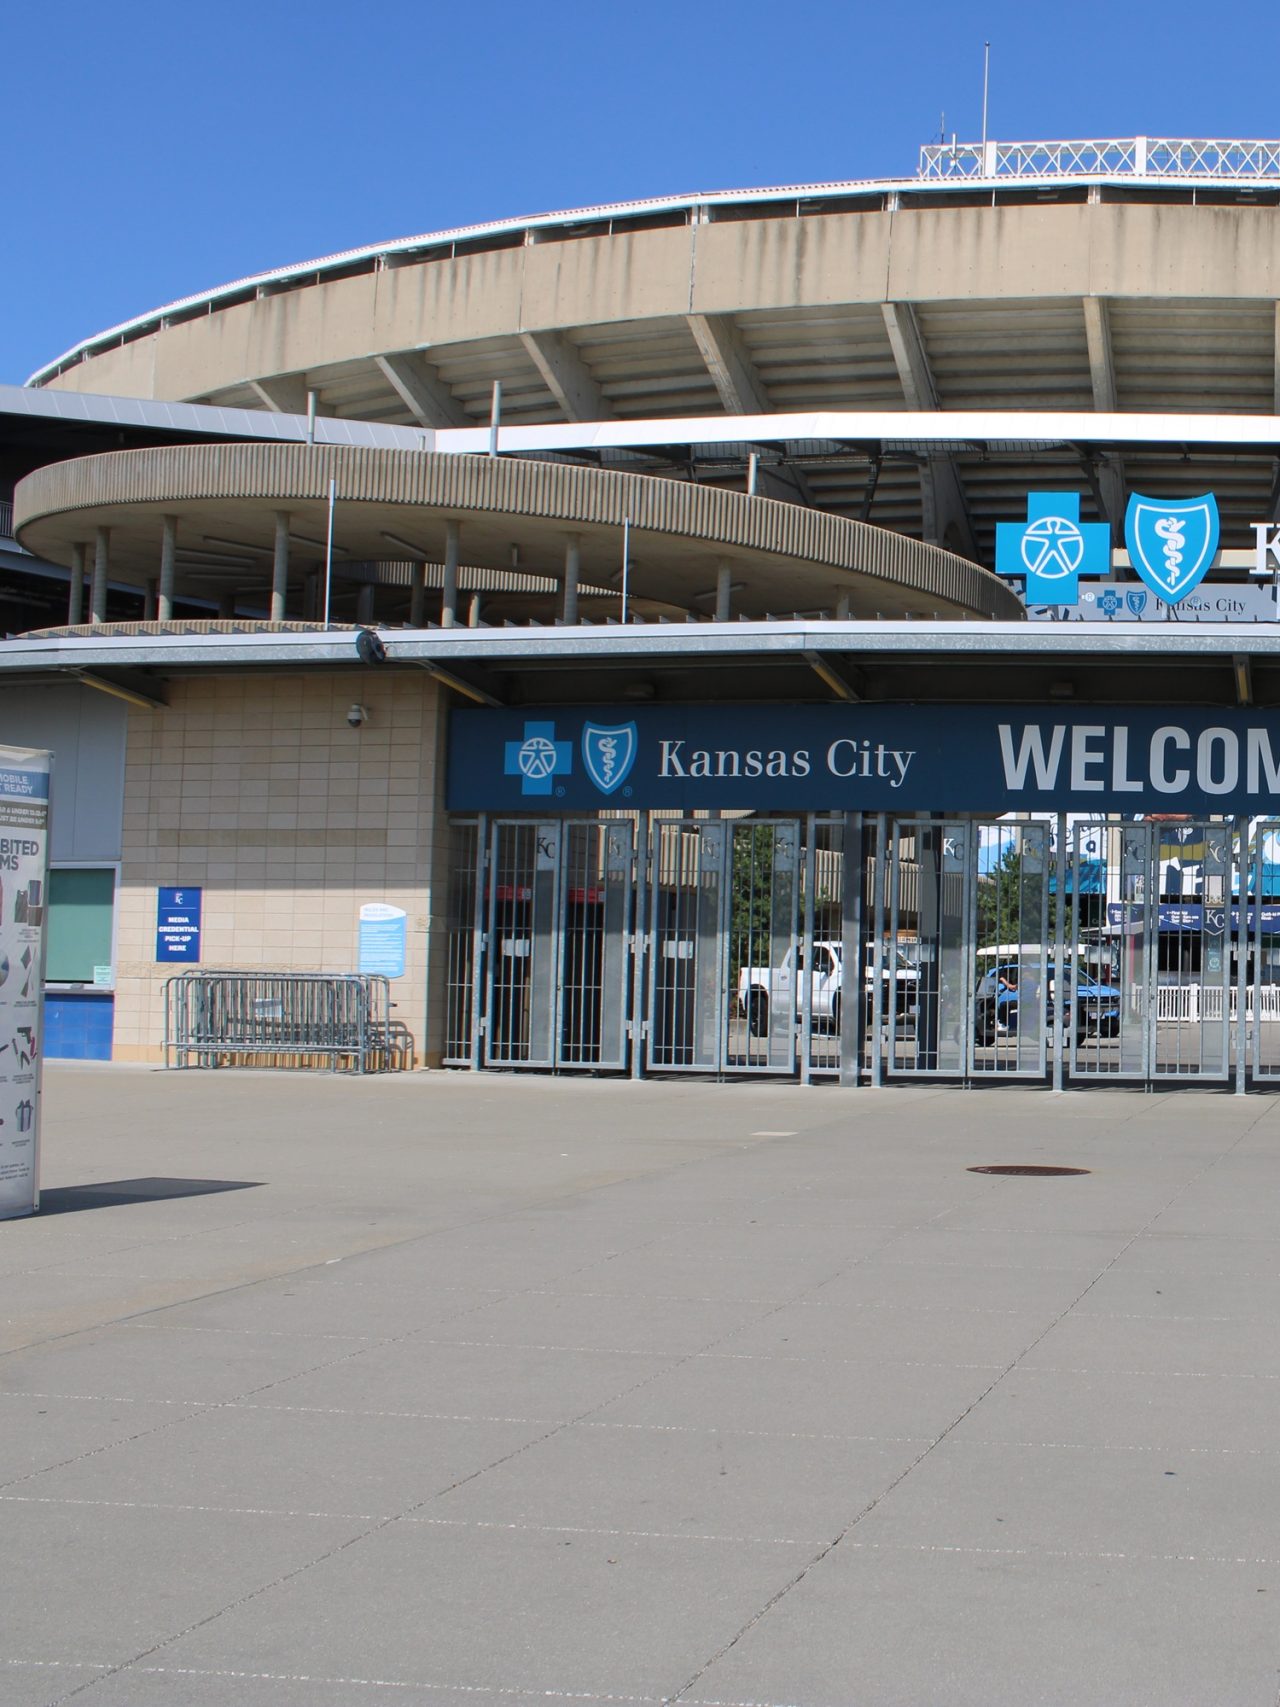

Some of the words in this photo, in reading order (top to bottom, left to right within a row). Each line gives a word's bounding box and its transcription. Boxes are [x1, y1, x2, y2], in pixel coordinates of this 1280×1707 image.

[1156, 598, 1211, 611] Knsas
[1215, 599, 1246, 615] City
[657, 740, 811, 777] Kansas
[826, 739, 917, 787] City
[3, 784, 33, 795] READY
[1, 838, 40, 857] BITED
[0, 855, 19, 871] MS
[1205, 909, 1225, 929] KC
